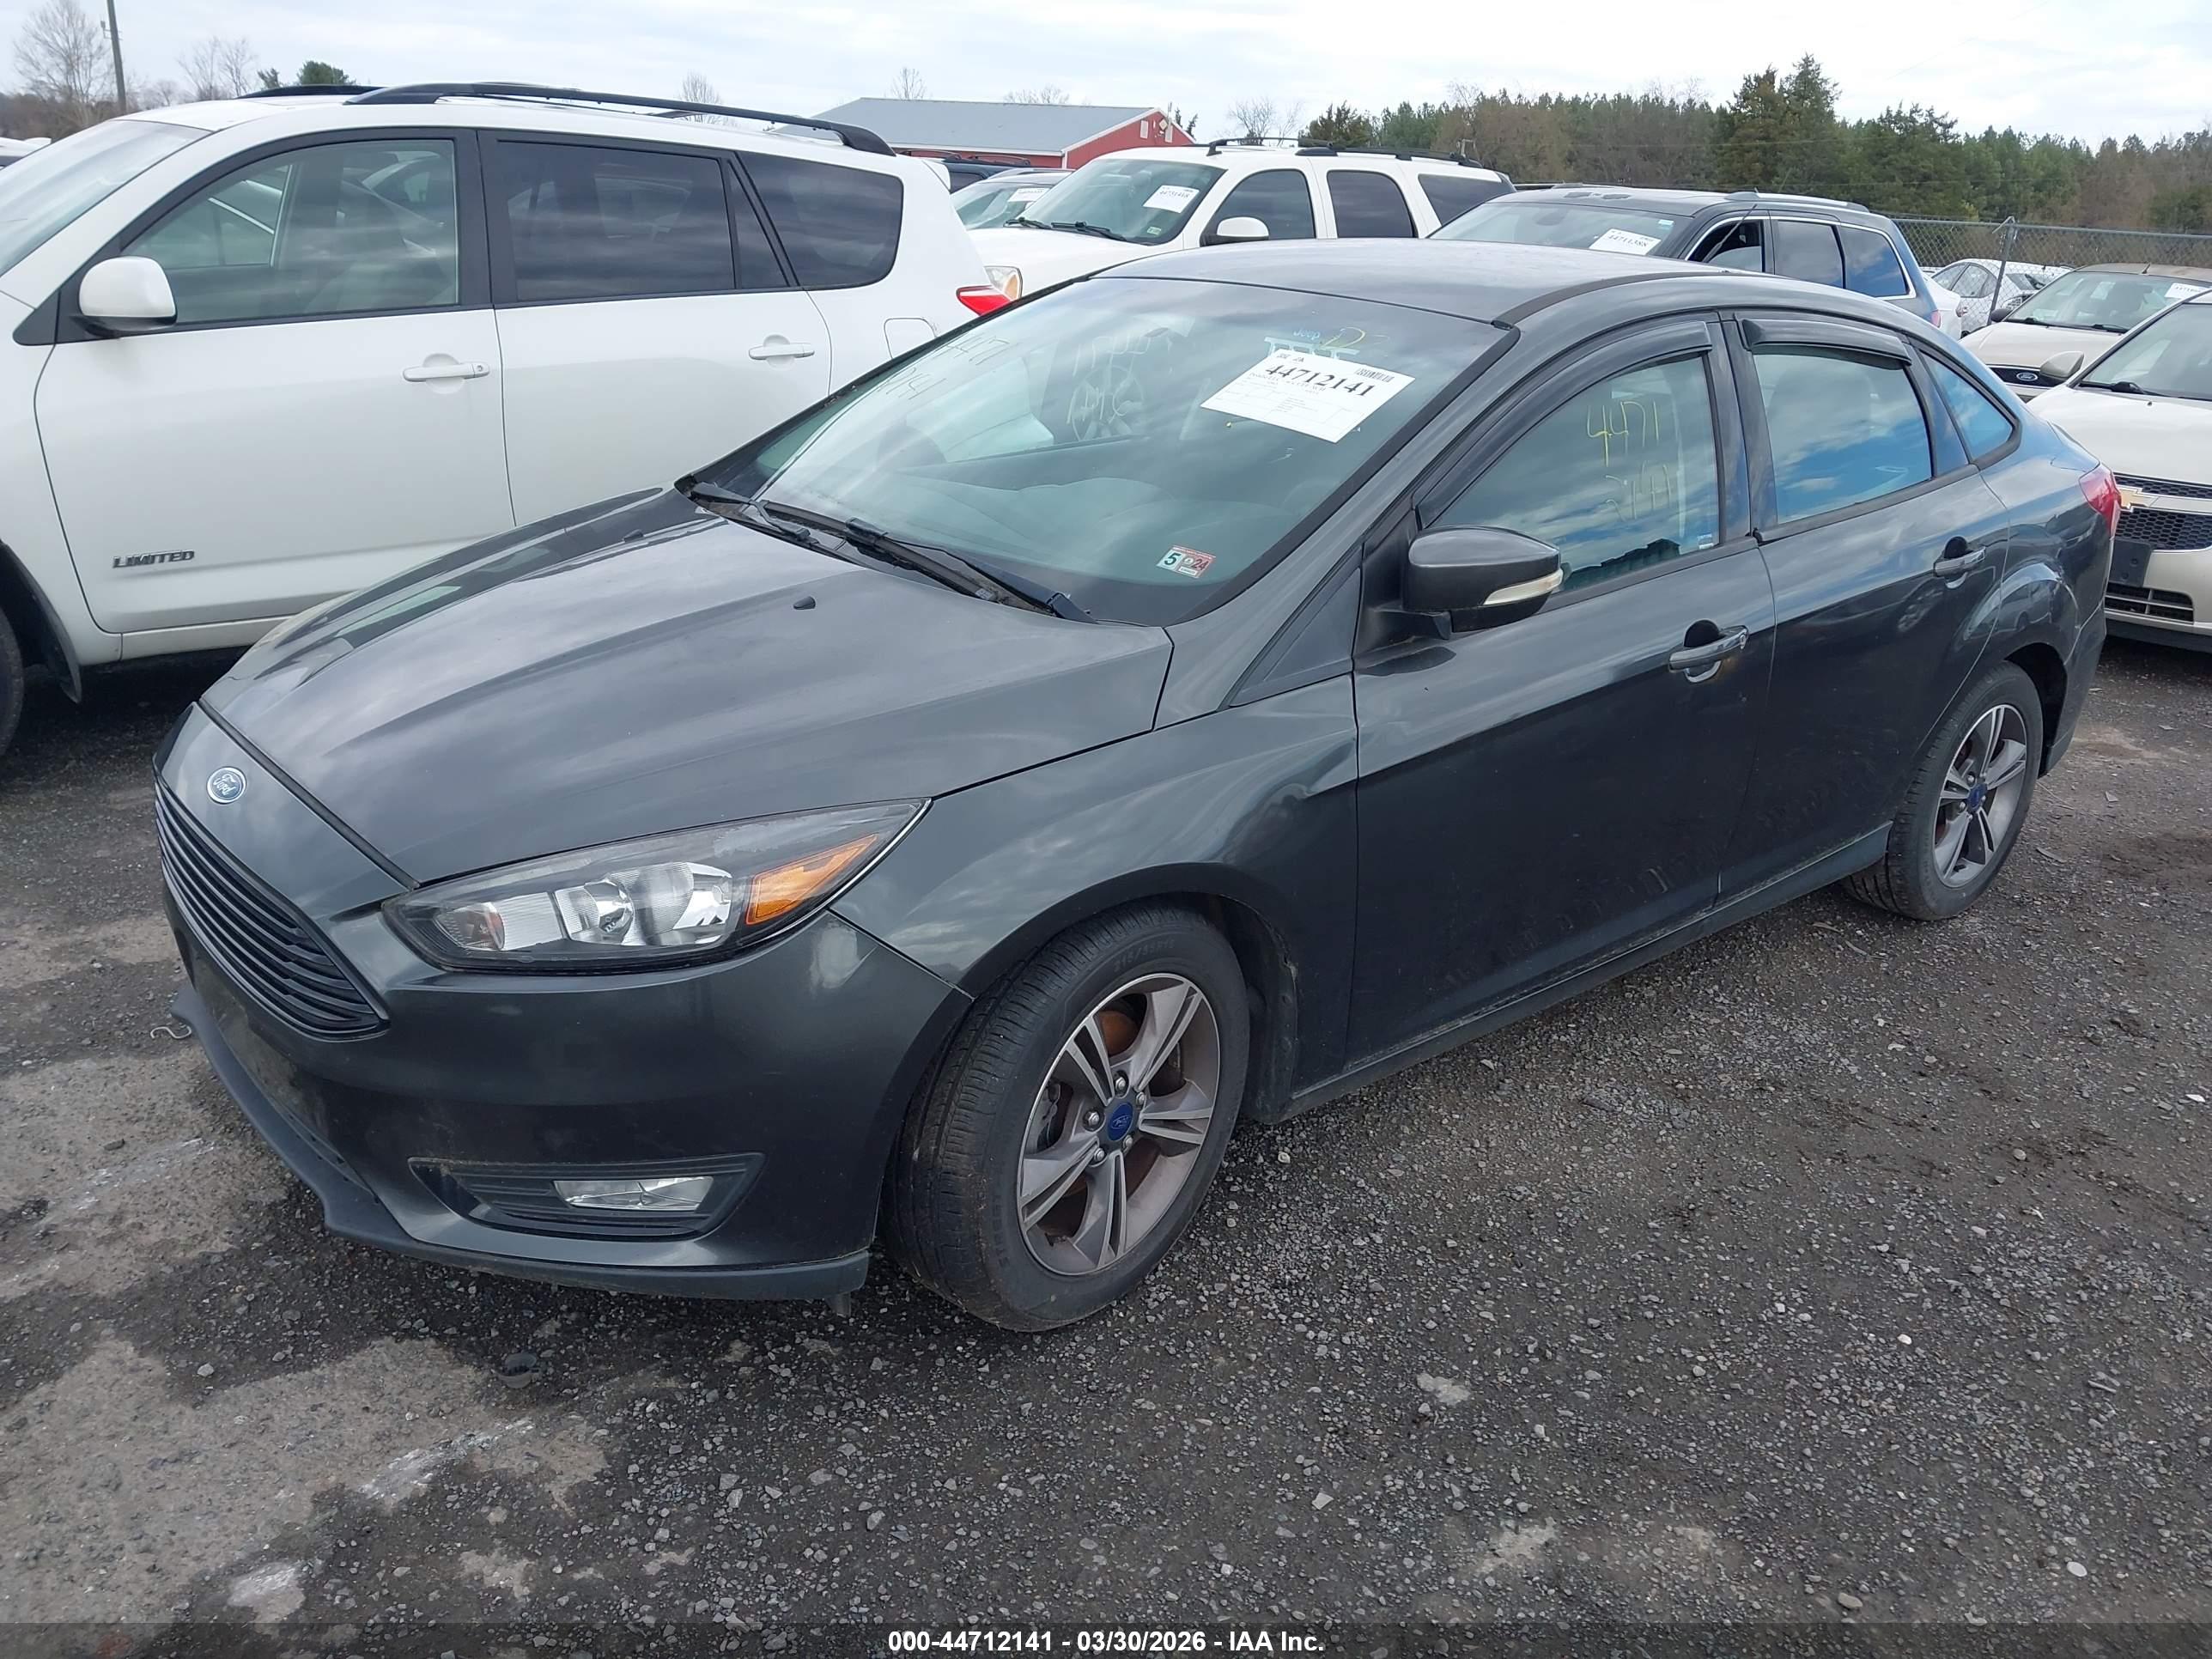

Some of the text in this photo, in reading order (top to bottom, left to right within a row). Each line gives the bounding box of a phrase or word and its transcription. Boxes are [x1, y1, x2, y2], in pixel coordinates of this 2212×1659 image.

[1265, 364, 1376, 397] 44712141
[1587, 400, 1660, 467] 4471
[112, 550, 195, 568] LIMITED
[1164, 552, 1209, 570] 5 24
[213, 773, 237, 795] Ford
